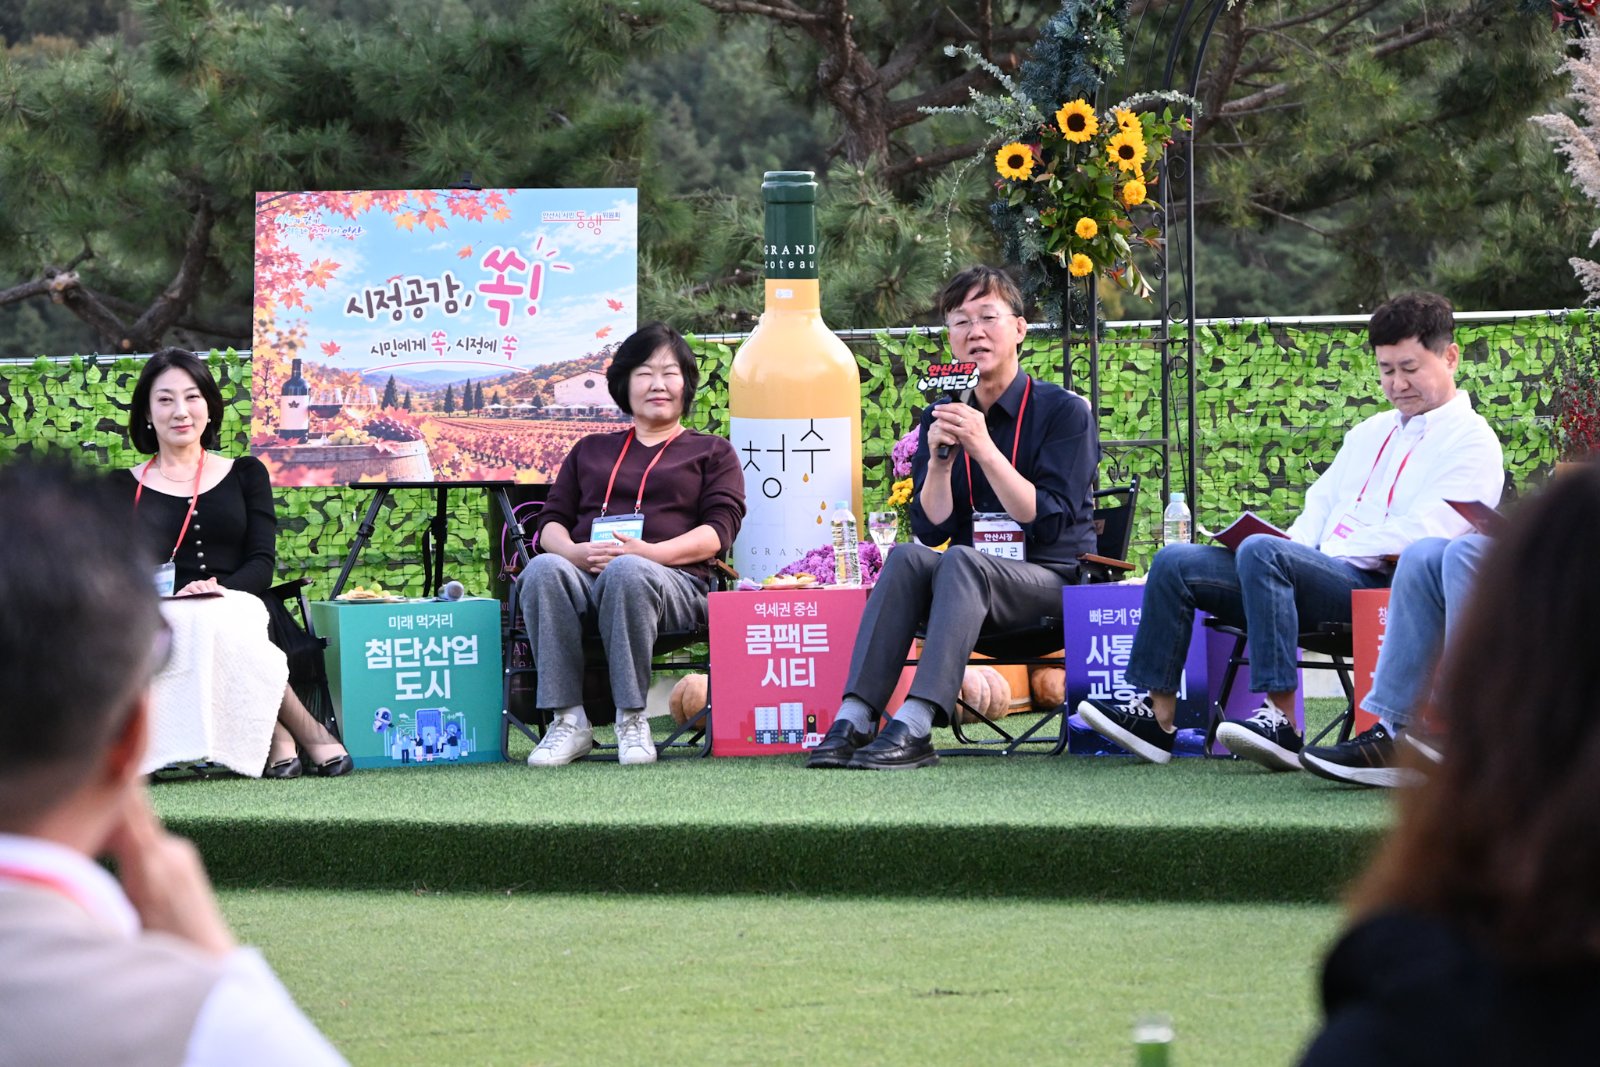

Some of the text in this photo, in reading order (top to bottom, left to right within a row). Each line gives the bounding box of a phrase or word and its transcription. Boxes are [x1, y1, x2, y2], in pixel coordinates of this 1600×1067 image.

[764, 244, 816, 255] GRAND
[346, 249, 542, 327] 시정공감, 쏙!
[370, 337, 427, 358] 시민에게
[456, 336, 497, 355] 시정에
[501, 335, 518, 361] 쏙
[928, 363, 976, 377] 안산시장
[927, 374, 970, 391] 이민근
[741, 418, 831, 499] 청수
[984, 533, 1014, 542] 안산시장
[751, 547, 804, 556] GRAN
[754, 601, 818, 618] 역세권 중심
[1089, 608, 1127, 626] 빠르게
[388, 613, 454, 630] 미래 먹거리
[745, 623, 830, 655] 콤팩트
[365, 634, 478, 669] 첨단산업
[1086, 634, 1134, 667] 사통
[761, 657, 816, 688] 시티
[395, 669, 451, 700] 도시
